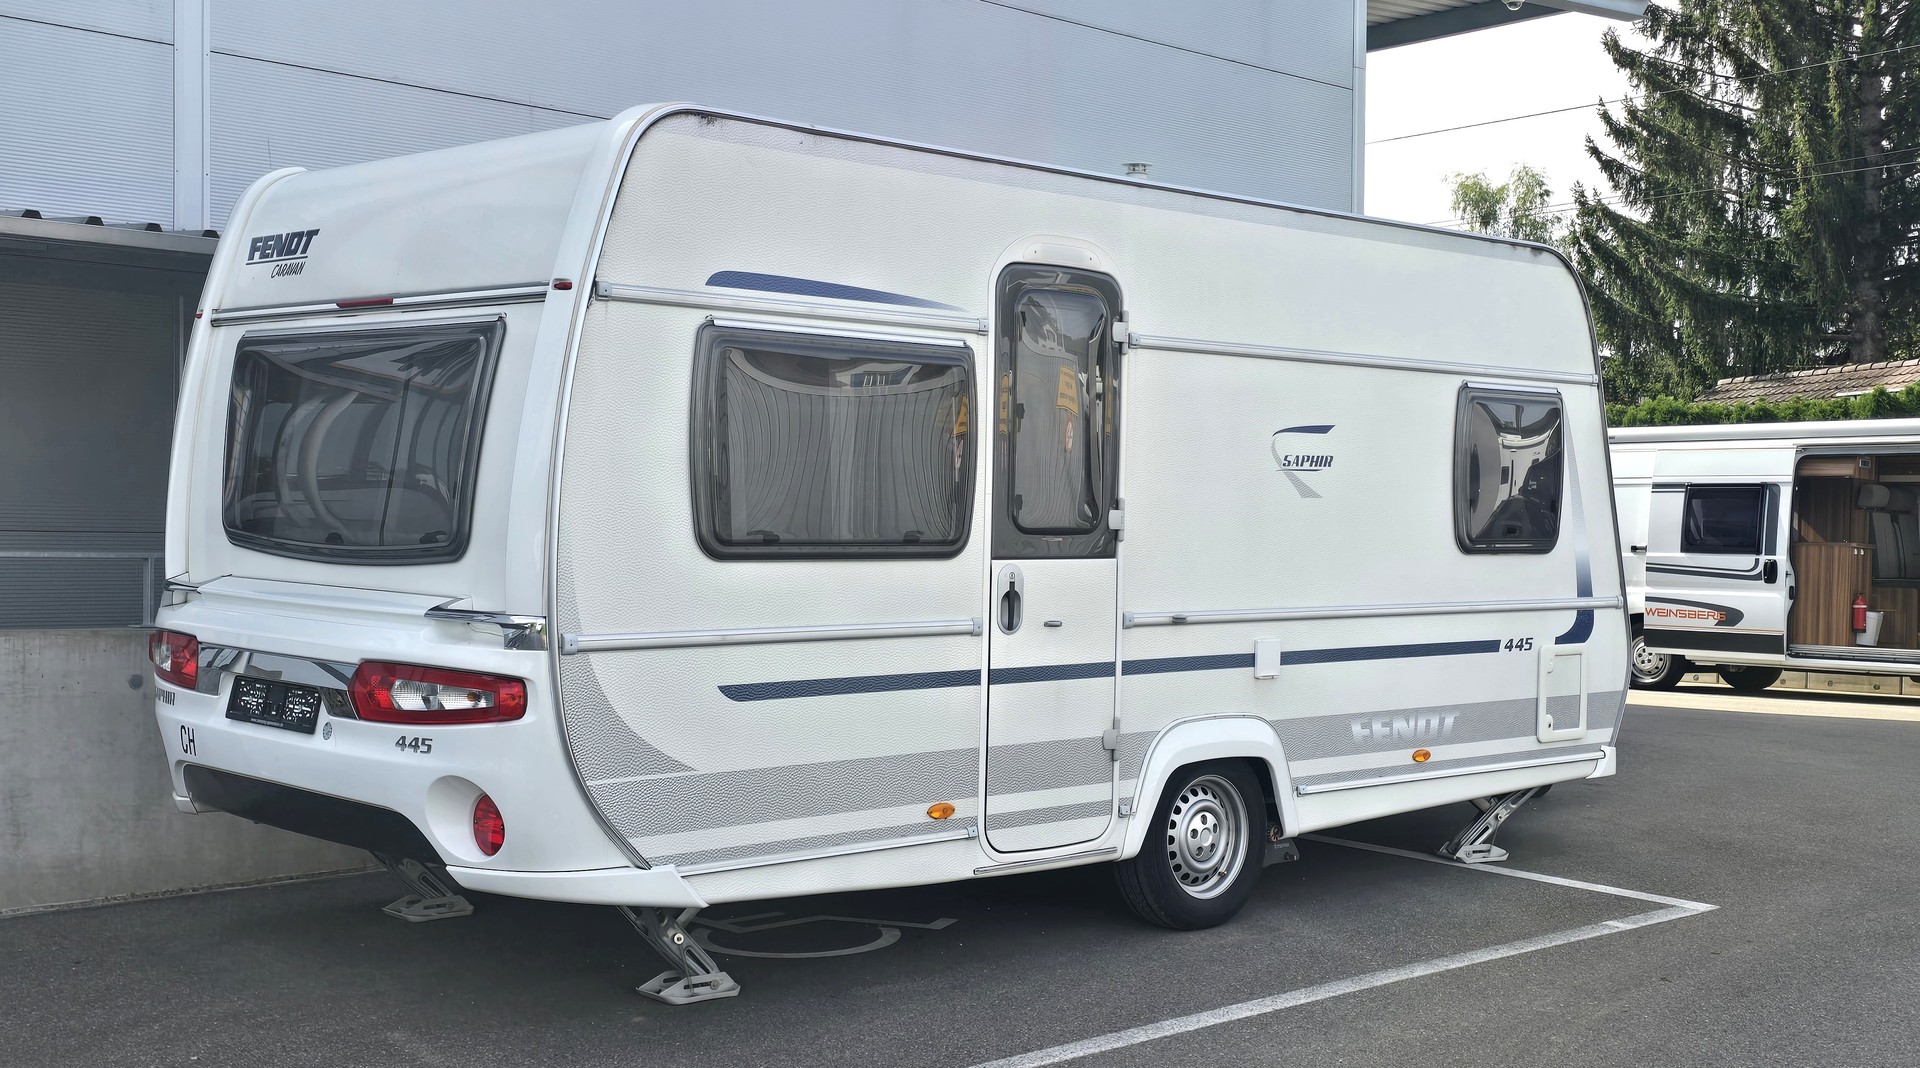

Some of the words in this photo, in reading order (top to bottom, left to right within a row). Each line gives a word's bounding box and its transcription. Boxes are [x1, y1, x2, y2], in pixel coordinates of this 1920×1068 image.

[247, 228, 321, 262] FENDT
[270, 261, 306, 279] CARAVAN
[1282, 454, 1334, 468] SAPHIR
[1644, 607, 1726, 622] WEINSBERG
[1503, 637, 1534, 653] 445
[1349, 710, 1460, 744] FENDT
[180, 724, 197, 757] CH
[395, 735, 433, 755] 445
